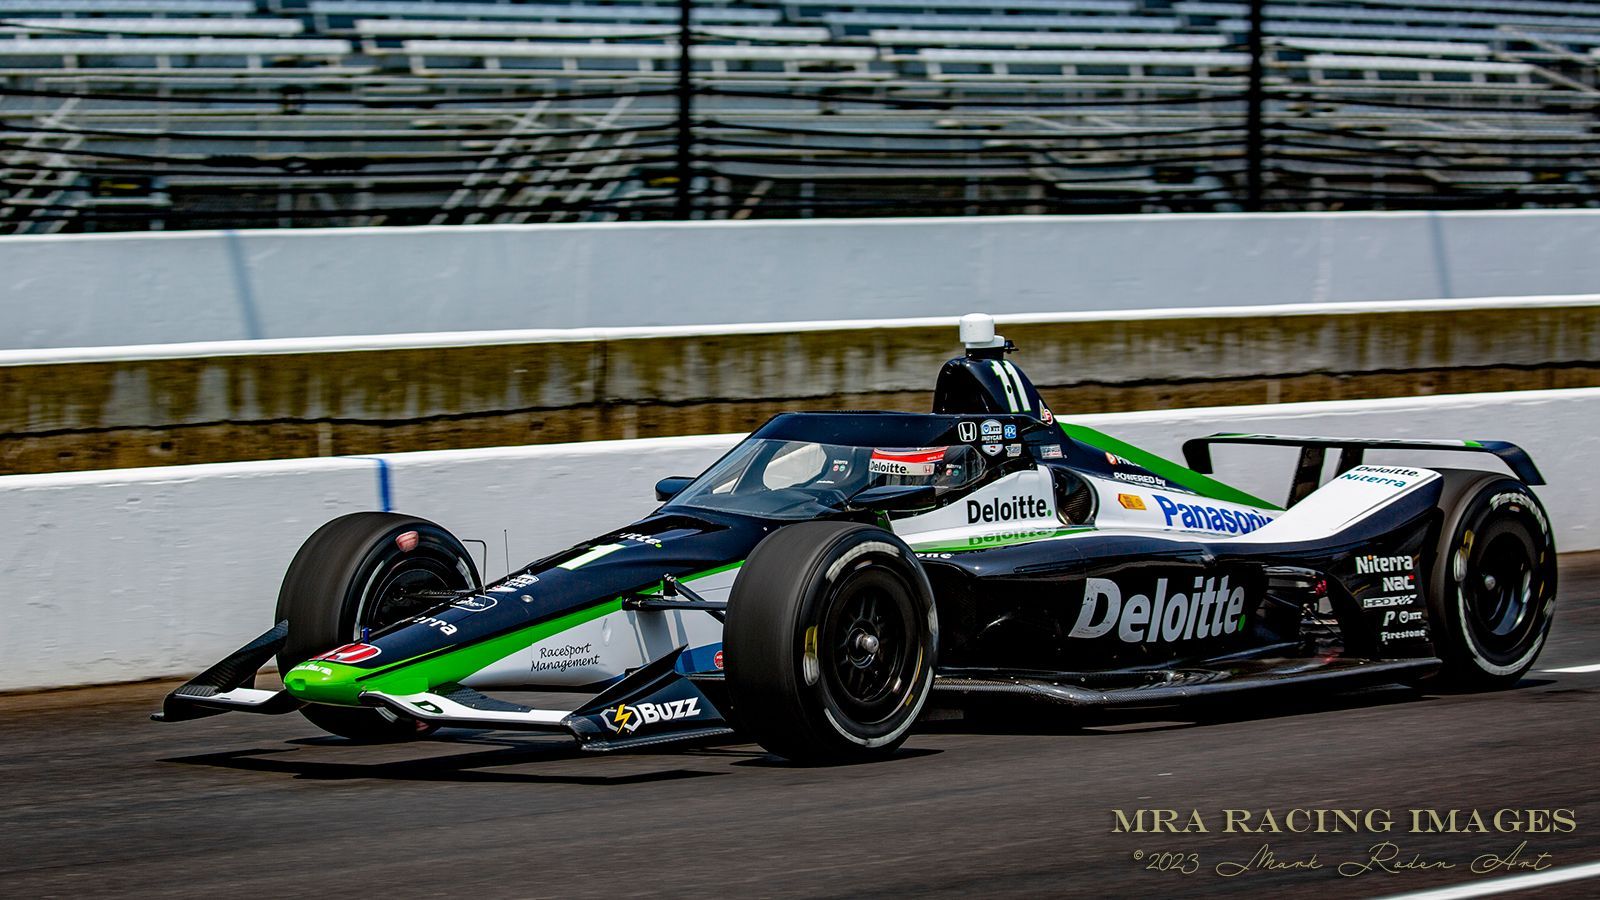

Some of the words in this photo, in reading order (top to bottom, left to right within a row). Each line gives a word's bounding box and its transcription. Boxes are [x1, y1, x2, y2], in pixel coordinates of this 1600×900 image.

[991, 360, 1032, 413] 11
[1113, 472, 1155, 484] POWERED
[1340, 473, 1407, 488] Niterra
[1355, 555, 1414, 575] Niterra
[1381, 630, 1426, 641] Firestone
[539, 643, 592, 658] RaceSport
[530, 655, 600, 672] Management
[637, 697, 701, 724] BUZZ
